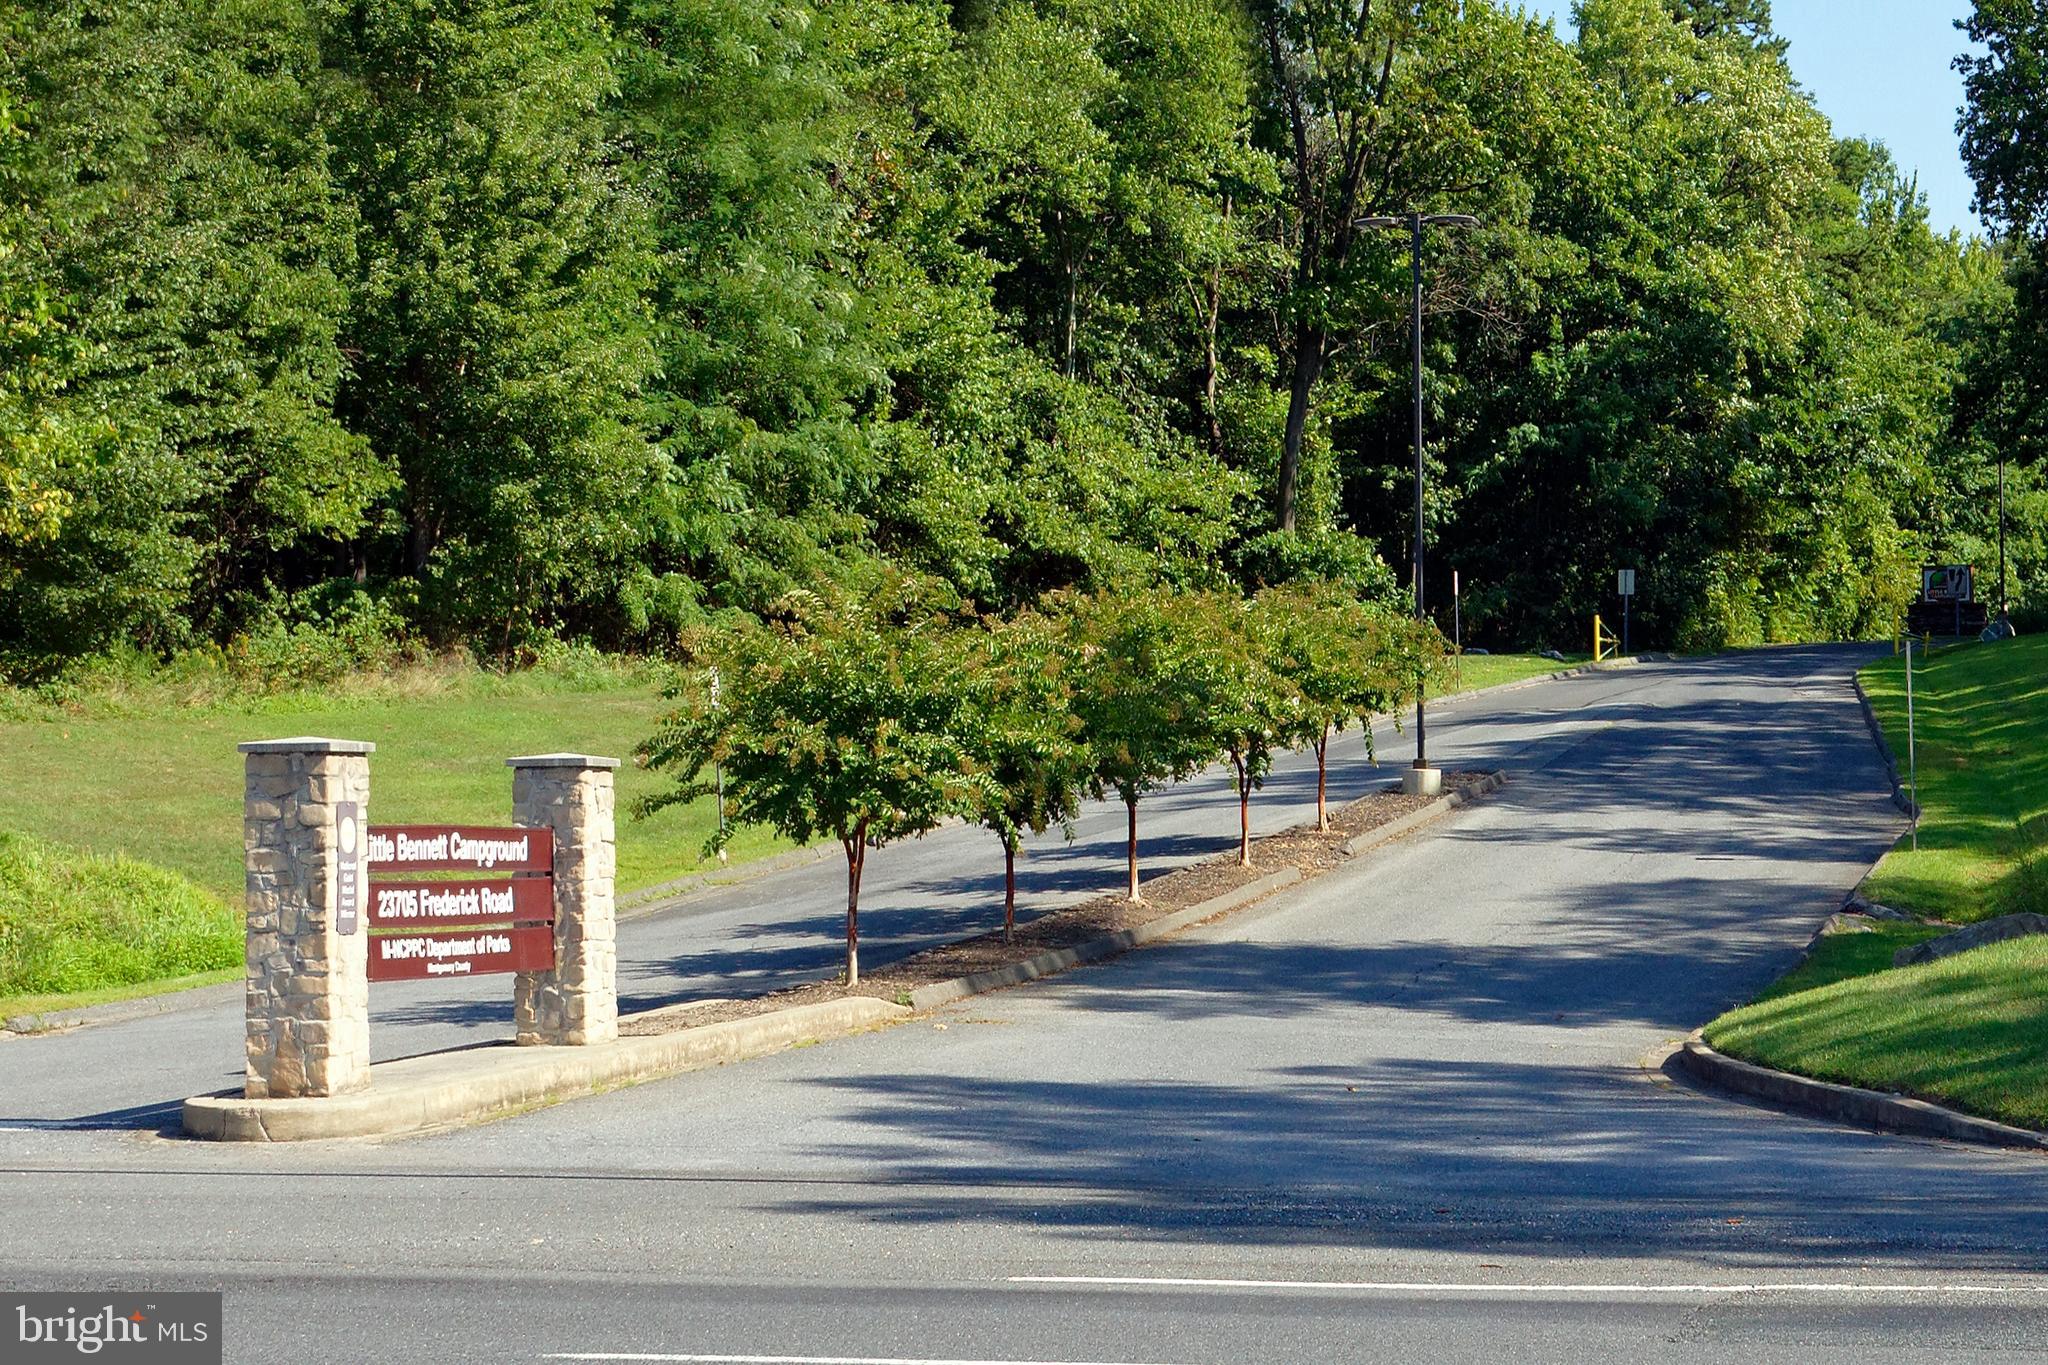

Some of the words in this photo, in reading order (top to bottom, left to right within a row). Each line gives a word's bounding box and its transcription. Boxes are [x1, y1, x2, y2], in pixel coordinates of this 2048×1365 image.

[397, 833, 448, 861] Bennett
[450, 832, 528, 867] Campground
[378, 890, 418, 918] 23705
[420, 888, 480, 917] Frederick
[481, 886, 513, 914] Road
[426, 937, 476, 960] Department
[476, 935, 486, 954] of
[486, 934, 512, 953] Parks
